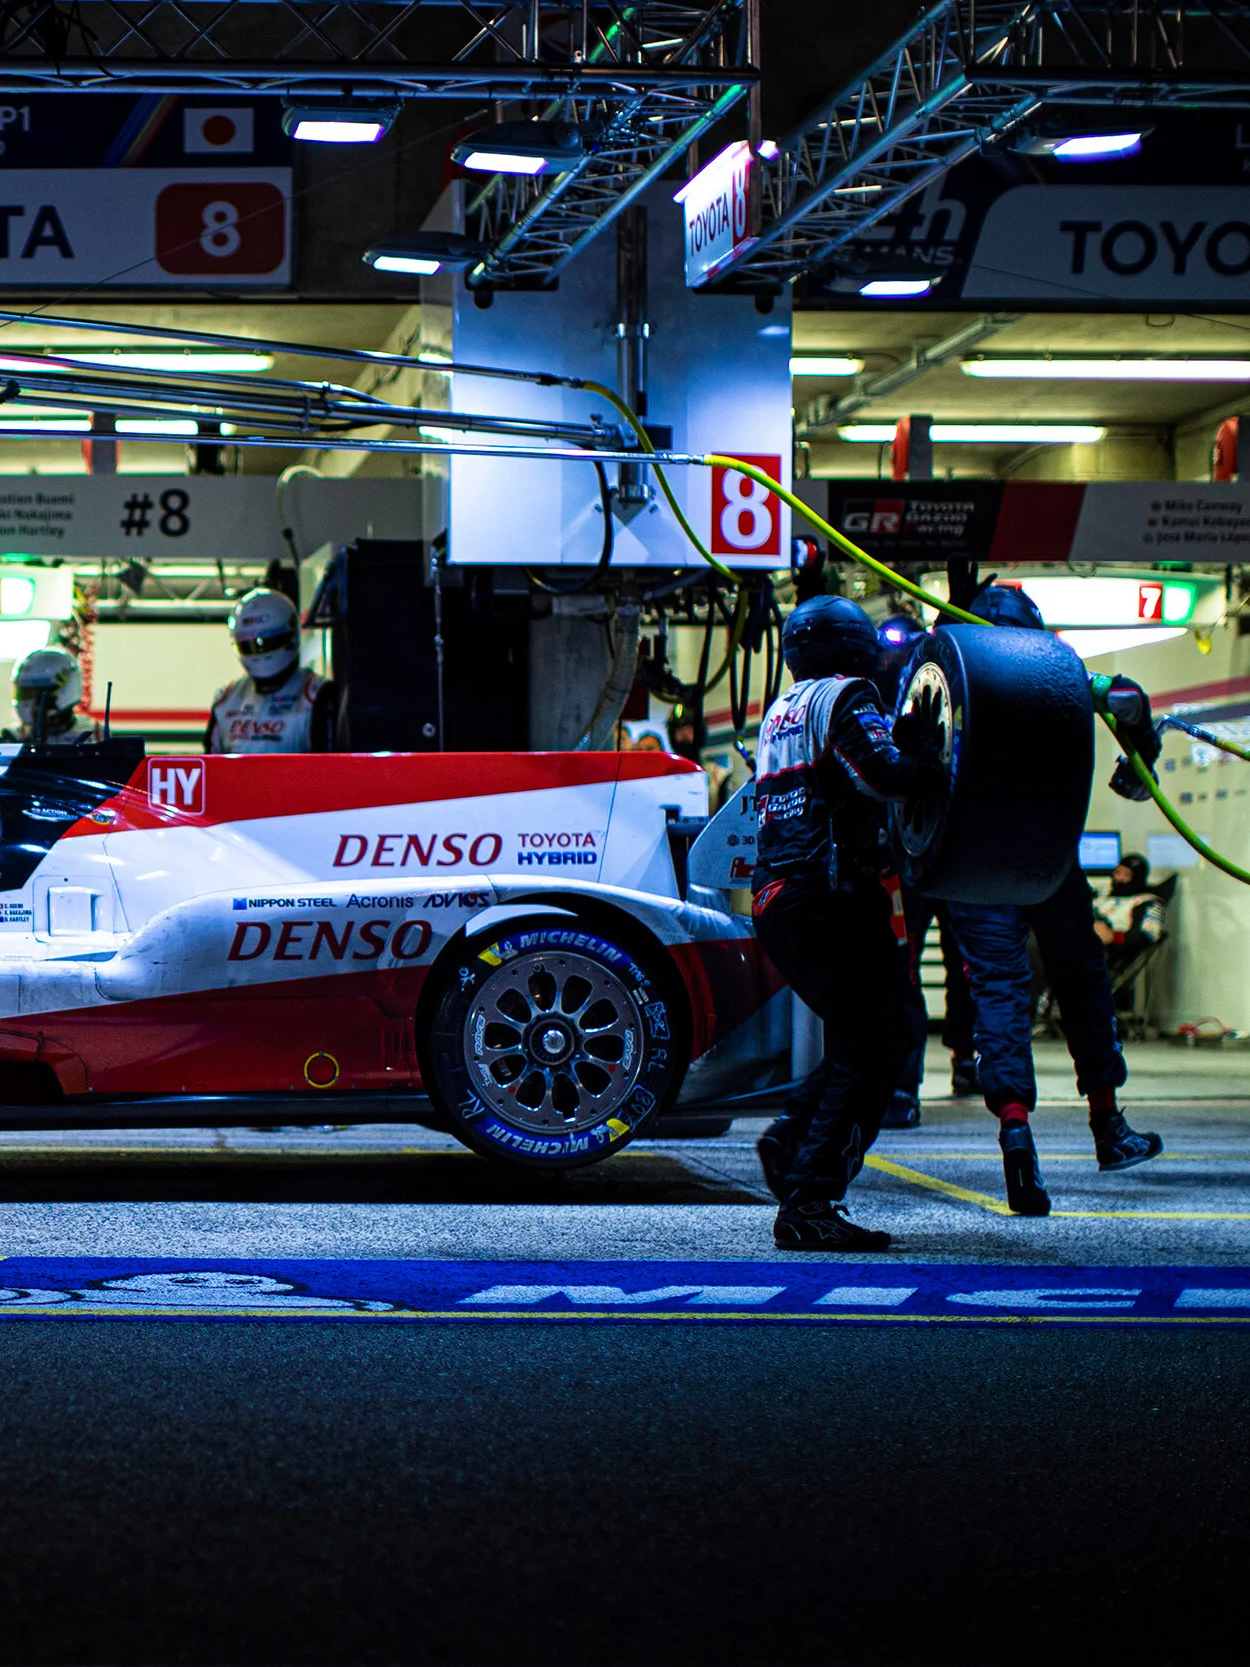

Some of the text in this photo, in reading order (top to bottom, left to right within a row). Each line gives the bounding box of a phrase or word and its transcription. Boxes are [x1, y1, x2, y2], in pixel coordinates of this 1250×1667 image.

[733, 165, 746, 238] 8
[200, 201, 242, 257] 8
[689, 192, 730, 256] TOYOTA
[121, 489, 190, 536] #8
[720, 465, 773, 549] 8
[843, 512, 899, 532] GR
[1140, 587, 1162, 618] 7
[230, 719, 285, 734] DENSO
[152, 768, 201, 805] HY
[332, 833, 503, 867] DENSO
[517, 833, 597, 847] TOYOTA
[517, 851, 598, 865] HYBRID
[248, 892, 493, 909] NIPPON STEEL Acronis ADVICS
[228, 919, 433, 961] DENSO
[519, 930, 623, 963] MICHELIN
[485, 1122, 590, 1156] MICHELIN
